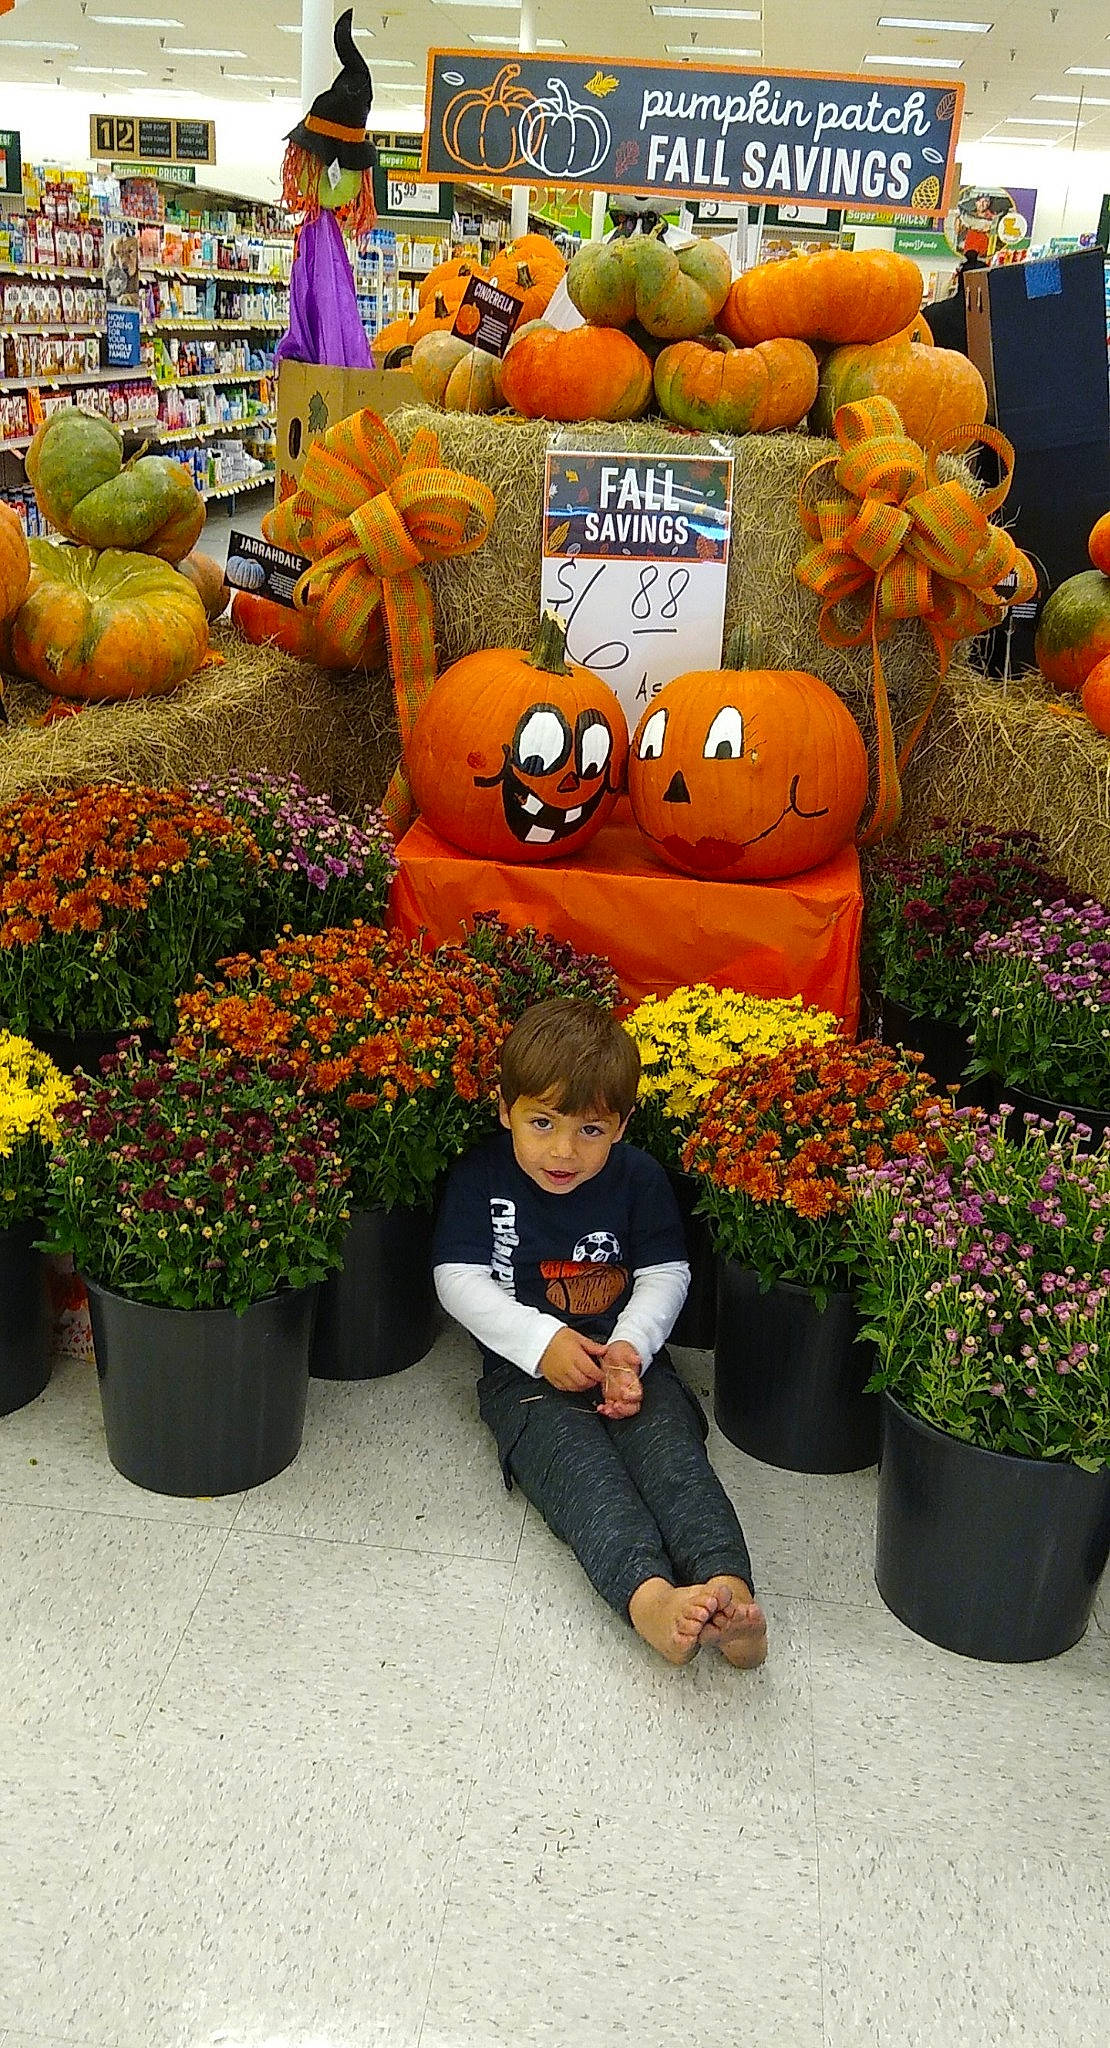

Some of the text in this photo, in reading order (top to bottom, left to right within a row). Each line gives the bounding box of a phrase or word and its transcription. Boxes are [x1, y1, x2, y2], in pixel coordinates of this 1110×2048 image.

[639, 79, 932, 142] pumpkin patch
[100, 121, 133, 148] 12
[379, 152, 403, 167] Super
[646, 133, 913, 200] FALL SAVINGS
[158, 167, 190, 182] PRICES!
[893, 213, 928, 226] PRICES!
[473, 282, 514, 315] CINDERELLA
[108, 321, 133, 330] CARING
[108, 335, 126, 343] YOUR
[108, 342, 132, 351] WHOLE
[108, 350, 132, 359] FAMILY
[599, 466, 680, 512] FALL
[585, 512, 690, 545] SAVINGS
[239, 536, 303, 571] JARRAHDALE
